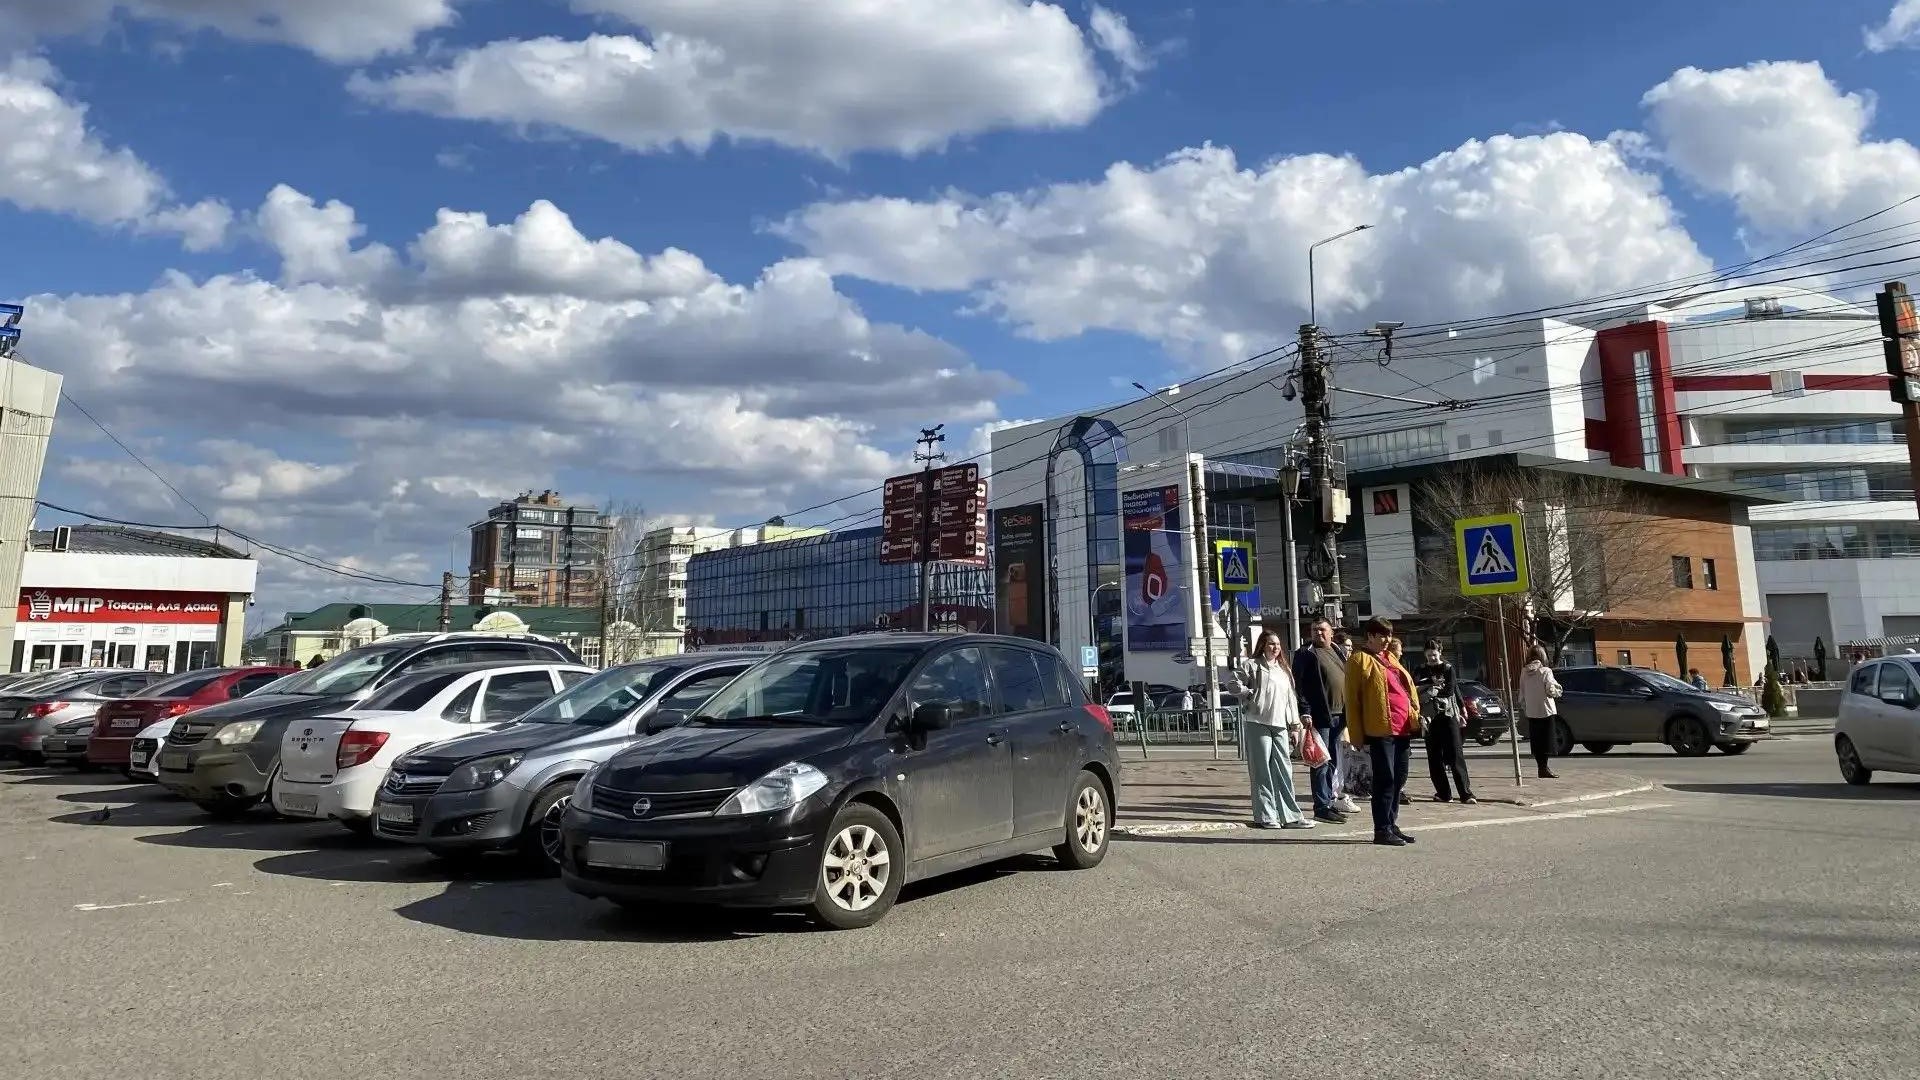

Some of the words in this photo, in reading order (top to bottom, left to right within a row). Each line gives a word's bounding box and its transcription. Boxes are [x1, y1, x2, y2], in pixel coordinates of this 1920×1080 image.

[1123, 491, 1160, 501] Выбирайте
[1002, 515, 1032, 527] ReSale
[53, 597, 103, 614] МПР
[107, 600, 153, 612] Товары
[157, 602, 180, 612] для
[183, 602, 218, 612] дома
[1086, 649, 1094, 662] P
